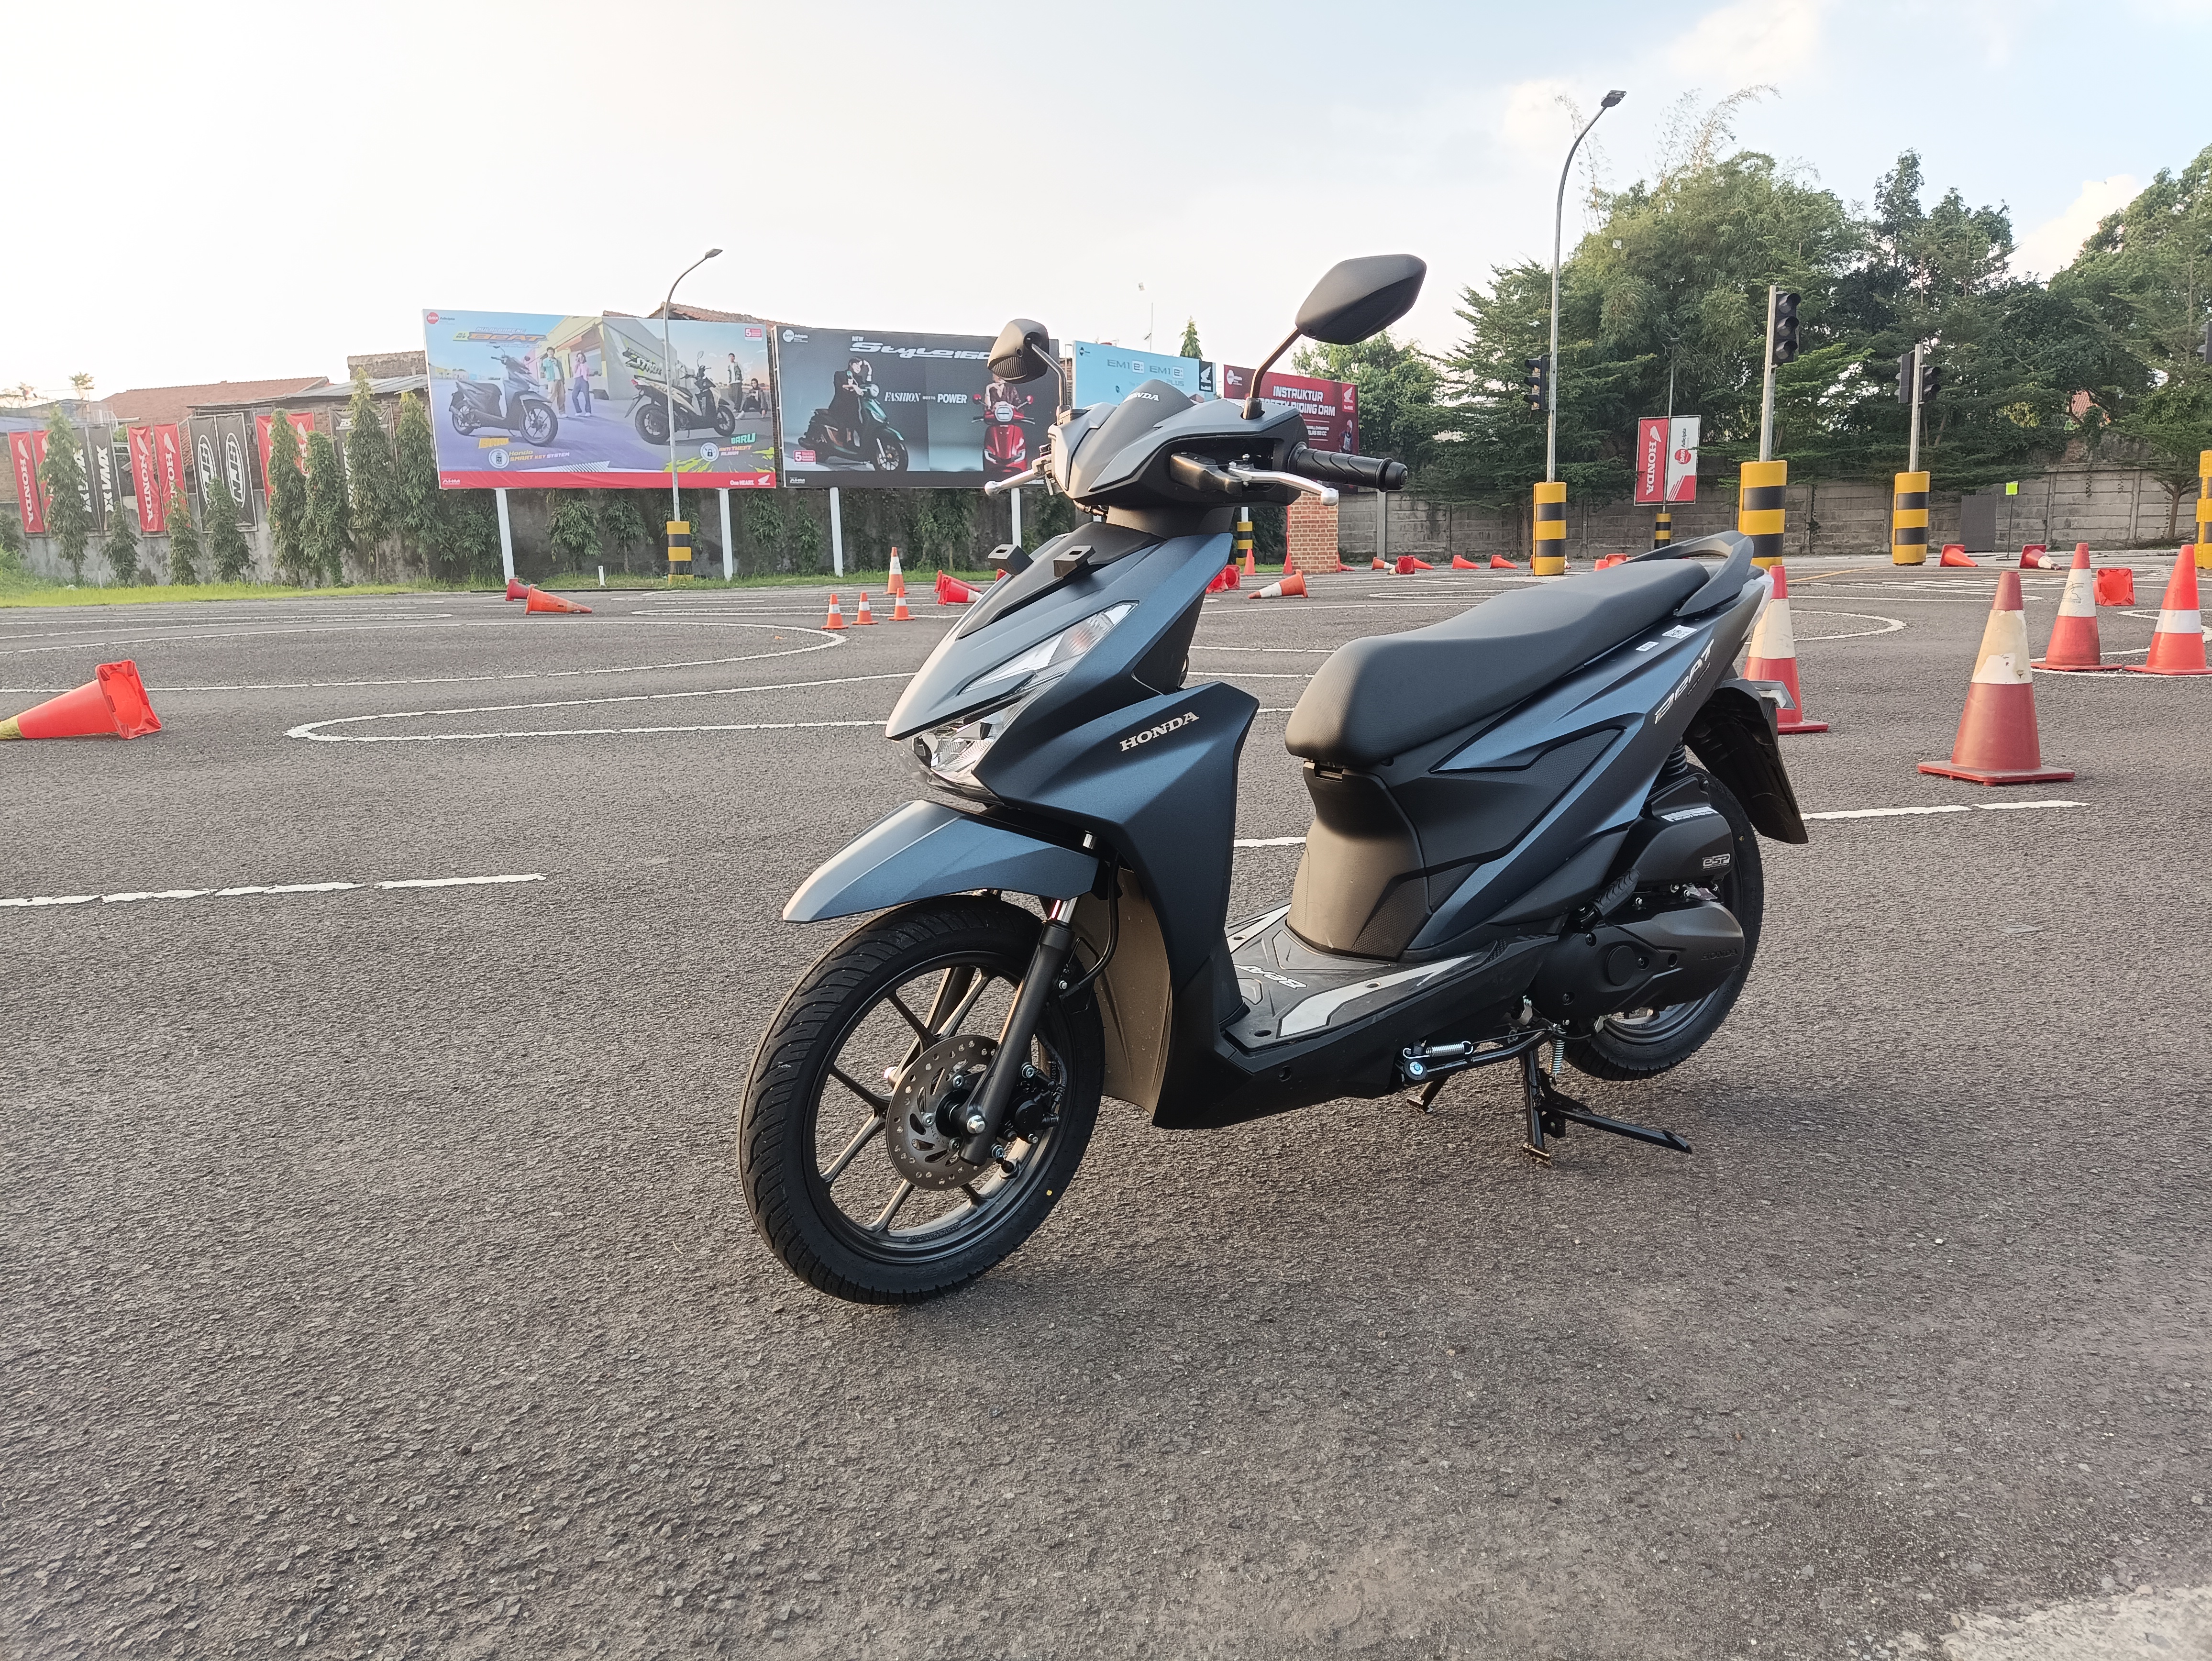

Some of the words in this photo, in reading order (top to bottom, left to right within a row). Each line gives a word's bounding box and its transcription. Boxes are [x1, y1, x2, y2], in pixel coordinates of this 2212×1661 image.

[746, 329, 752, 337] 5
[1107, 359, 1130, 369] EM1
[1150, 365, 1171, 375] EM1
[885, 392, 921, 402] FASHION
[937, 393, 967, 403] POWER
[1123, 392, 1160, 401] ONDA
[1273, 386, 1323, 402] INSTRUKTUR
[731, 432, 756, 444] BARU
[795, 452, 802, 461] 5
[1646, 441, 1657, 496] HONDA
[20, 458, 34, 525] HONDA
[138, 454, 153, 523] HONDA
[1119, 711, 1200, 752] HONDA
[1701, 948, 1737, 961] HONDA
[1234, 964, 1308, 990] BeA
